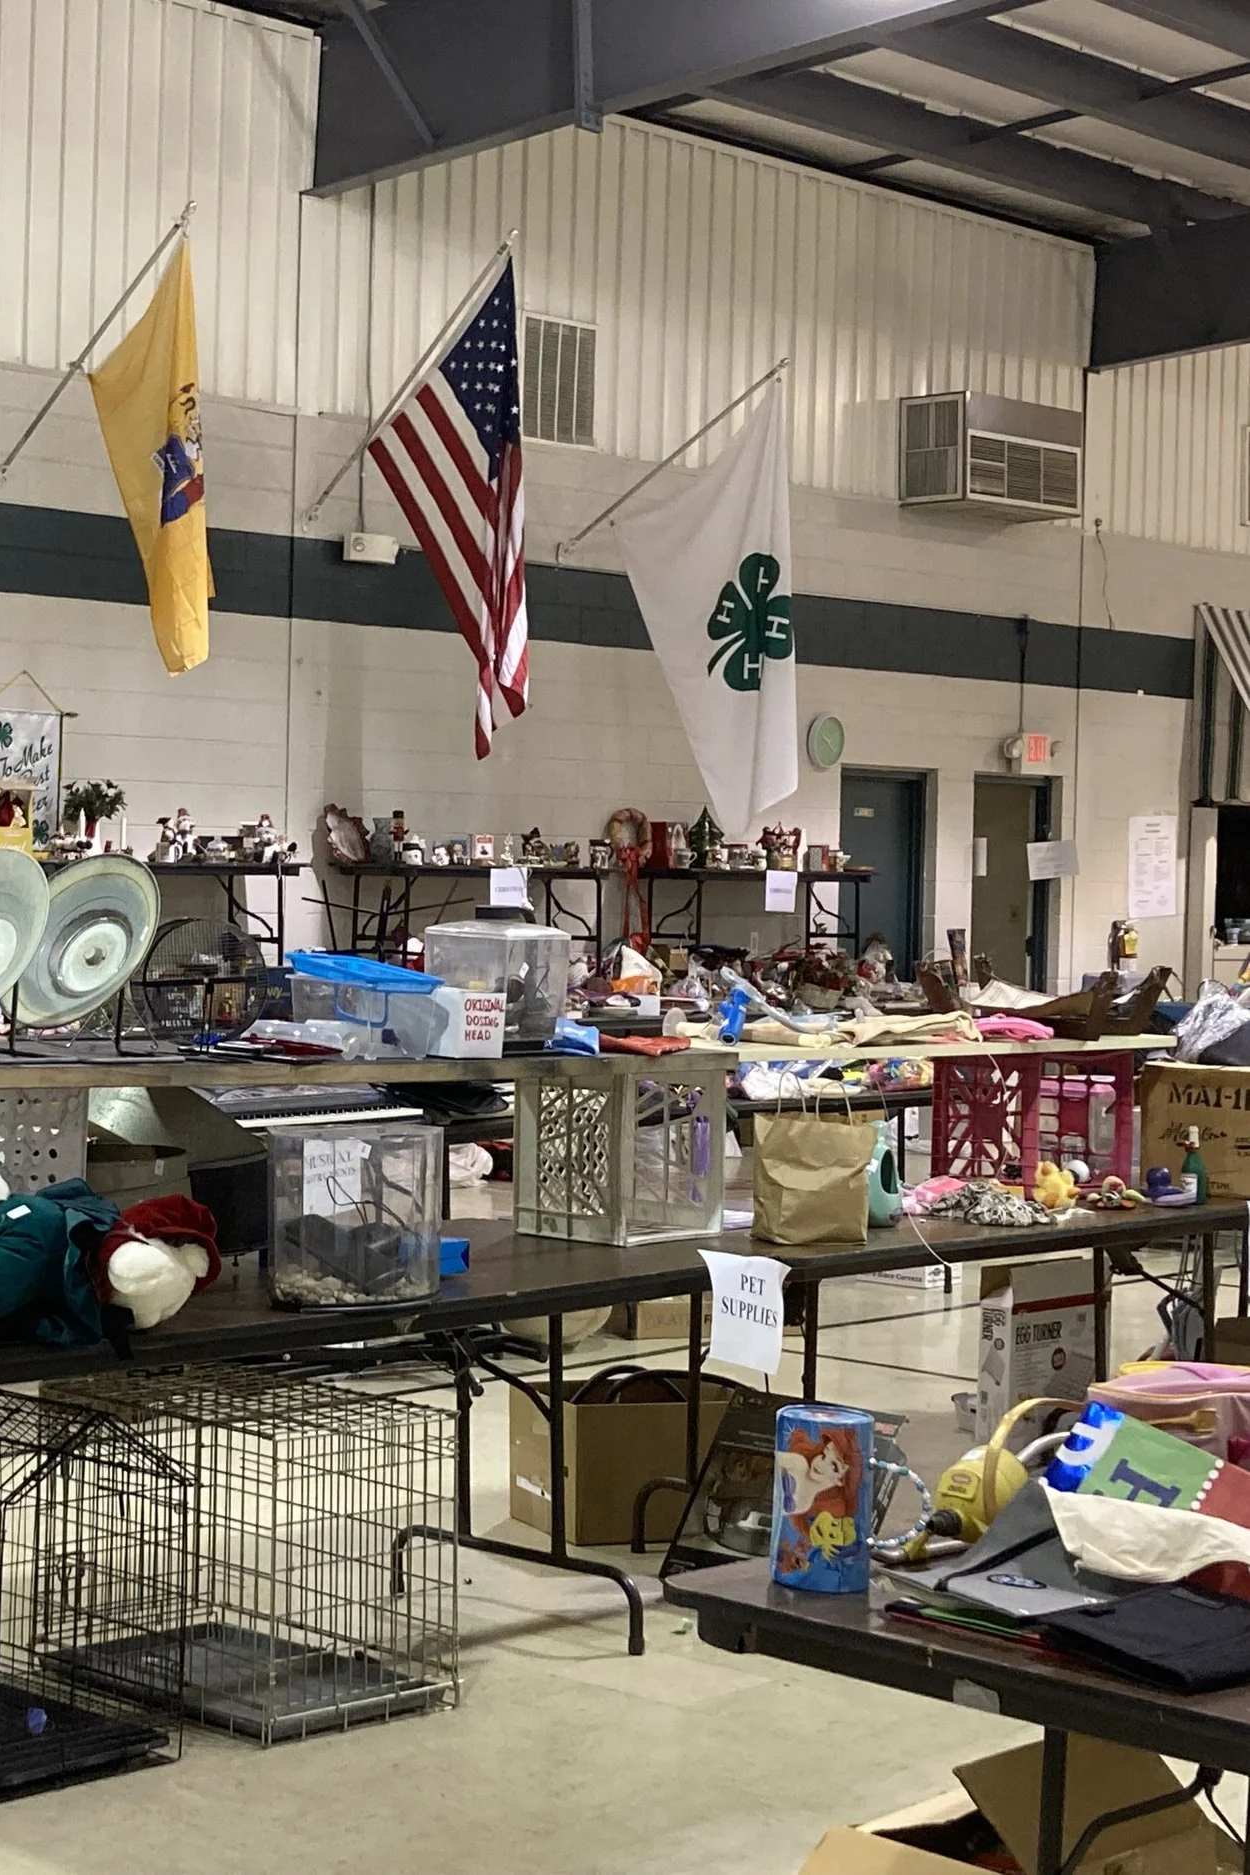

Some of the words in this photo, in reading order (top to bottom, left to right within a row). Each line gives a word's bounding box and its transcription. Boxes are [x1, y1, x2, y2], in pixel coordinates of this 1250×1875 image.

[14, 736, 54, 773] Make
[464, 997, 505, 1012] ORIGINAL
[465, 1014, 500, 1028] DOSING
[464, 1030, 491, 1041] HEAD
[740, 1272, 766, 1296] PET
[720, 1296, 778, 1328] SUPPLIES
[1015, 1324, 1031, 1345] EGG
[1032, 1320, 1063, 1342] TURNER
